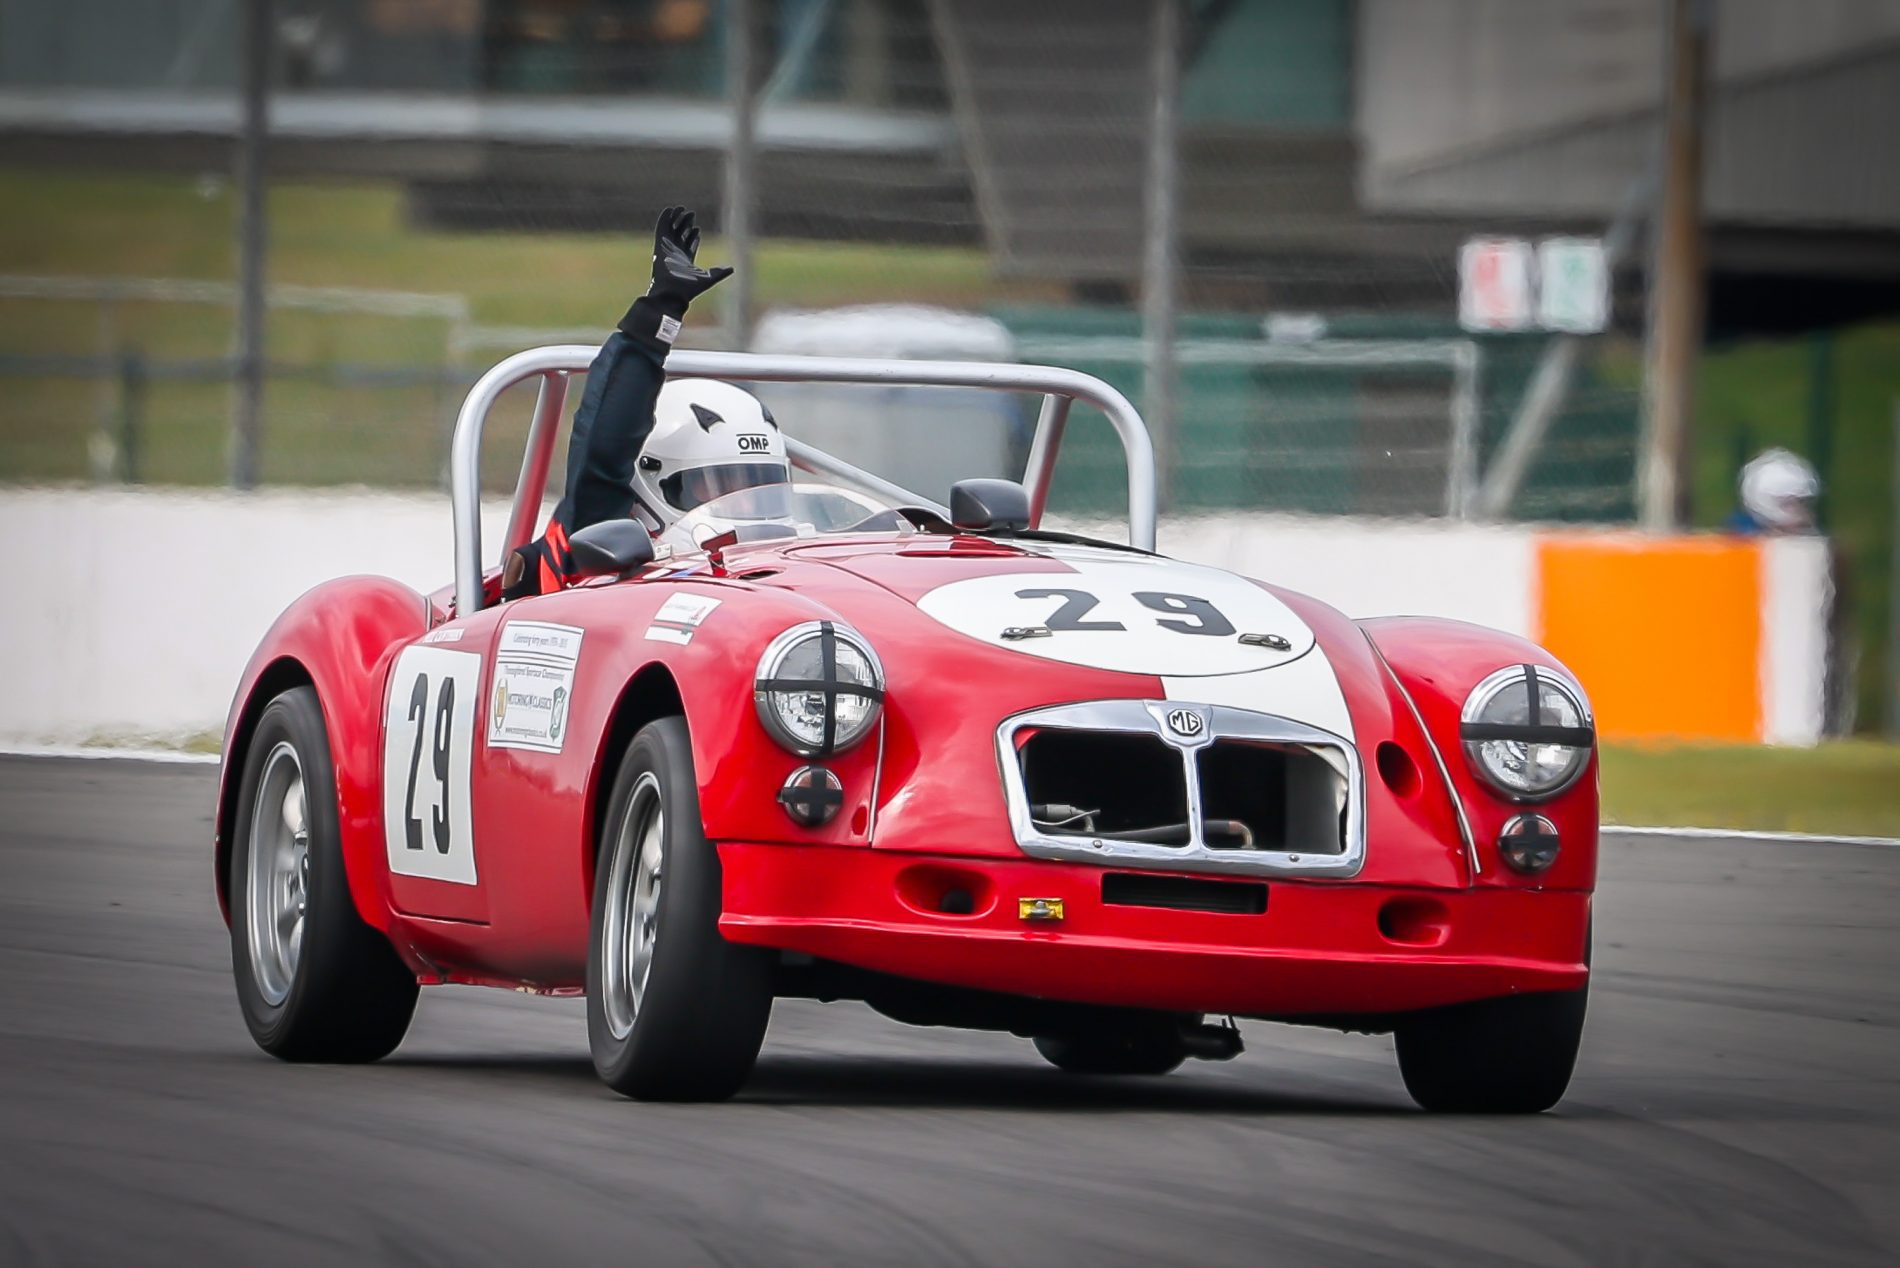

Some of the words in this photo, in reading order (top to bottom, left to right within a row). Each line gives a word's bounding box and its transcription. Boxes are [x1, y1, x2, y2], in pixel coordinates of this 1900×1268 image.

[738, 437, 769, 450] OMP
[1014, 588, 1237, 636] 29
[1172, 711, 1199, 731] MG
[405, 673, 455, 854] 29
